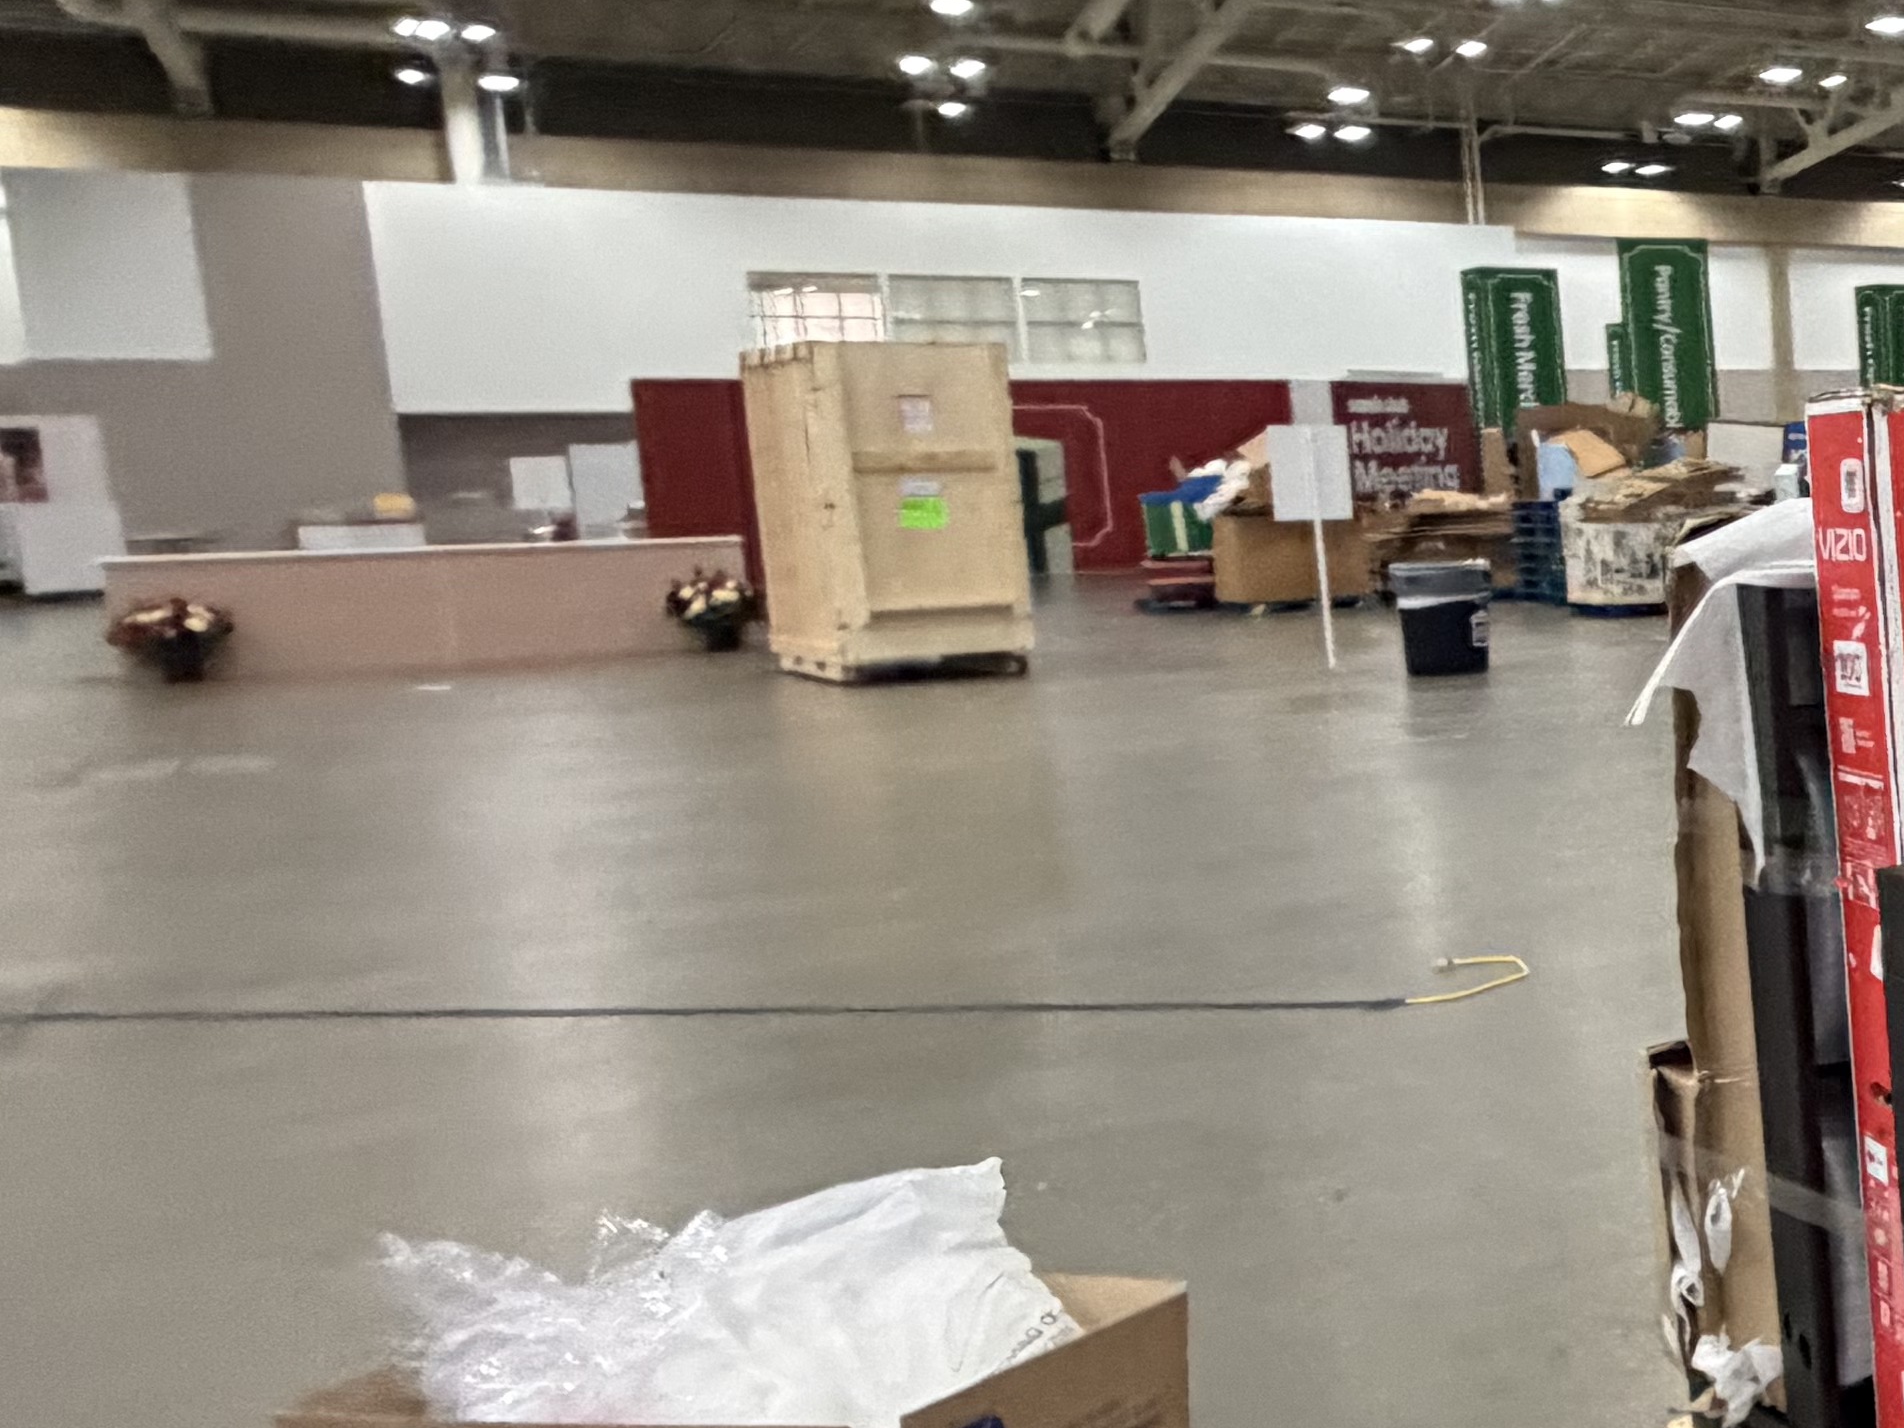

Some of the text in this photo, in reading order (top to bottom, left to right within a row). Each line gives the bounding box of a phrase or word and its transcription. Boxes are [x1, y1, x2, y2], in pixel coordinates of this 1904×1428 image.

[1510, 292, 1536, 348] Fresh
[1351, 418, 1447, 460] Holiday
[1819, 527, 1867, 562] VIZIO
